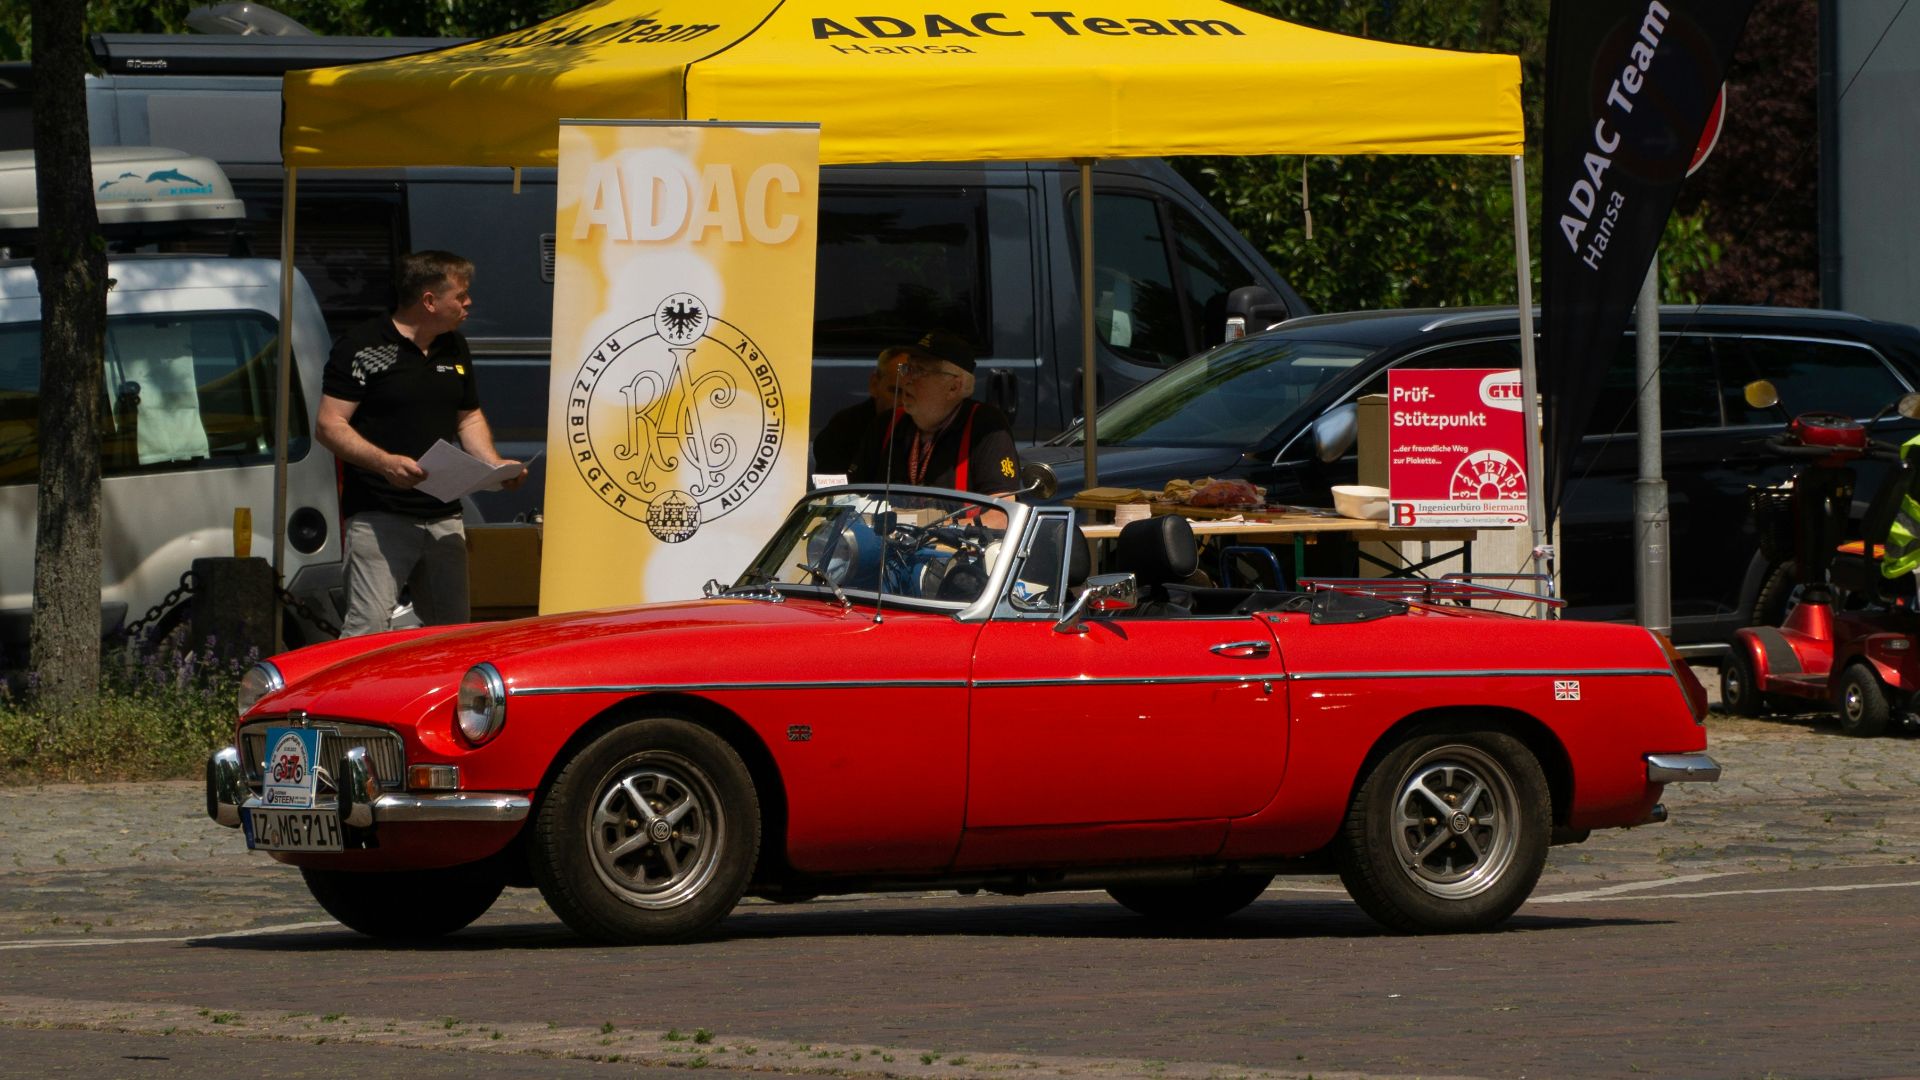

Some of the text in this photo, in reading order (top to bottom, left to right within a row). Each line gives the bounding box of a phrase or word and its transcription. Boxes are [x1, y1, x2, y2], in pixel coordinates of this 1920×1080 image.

[601, 19, 720, 44] Team
[811, 11, 1247, 40] ADAC Team
[828, 43, 977, 56] Hansa
[1559, 0, 1671, 254] ADAC Team
[573, 162, 802, 246] ADAC
[1582, 190, 1626, 272] Hansa
[1393, 386, 1435, 402] Prüf-
[1488, 382, 1523, 399] GTÜ
[569, 337, 627, 509] RATZEBURGER
[719, 337, 780, 510] AUTOMOBIL-CLUB e.V.
[1393, 411, 1487, 430] Stützpunkt
[1412, 444, 1451, 453] freundliche
[1452, 445, 1469, 454] Weg
[1484, 461, 1495, 473] 12
[1498, 464, 1508, 477] 11
[1463, 476, 1473, 487] 2
[1505, 474, 1517, 487] 10
[1418, 502, 1525, 513] Ingenieurbüro Biermann
[274, 796, 294, 804] STEEN
[252, 813, 342, 847] IZ MG 71H
